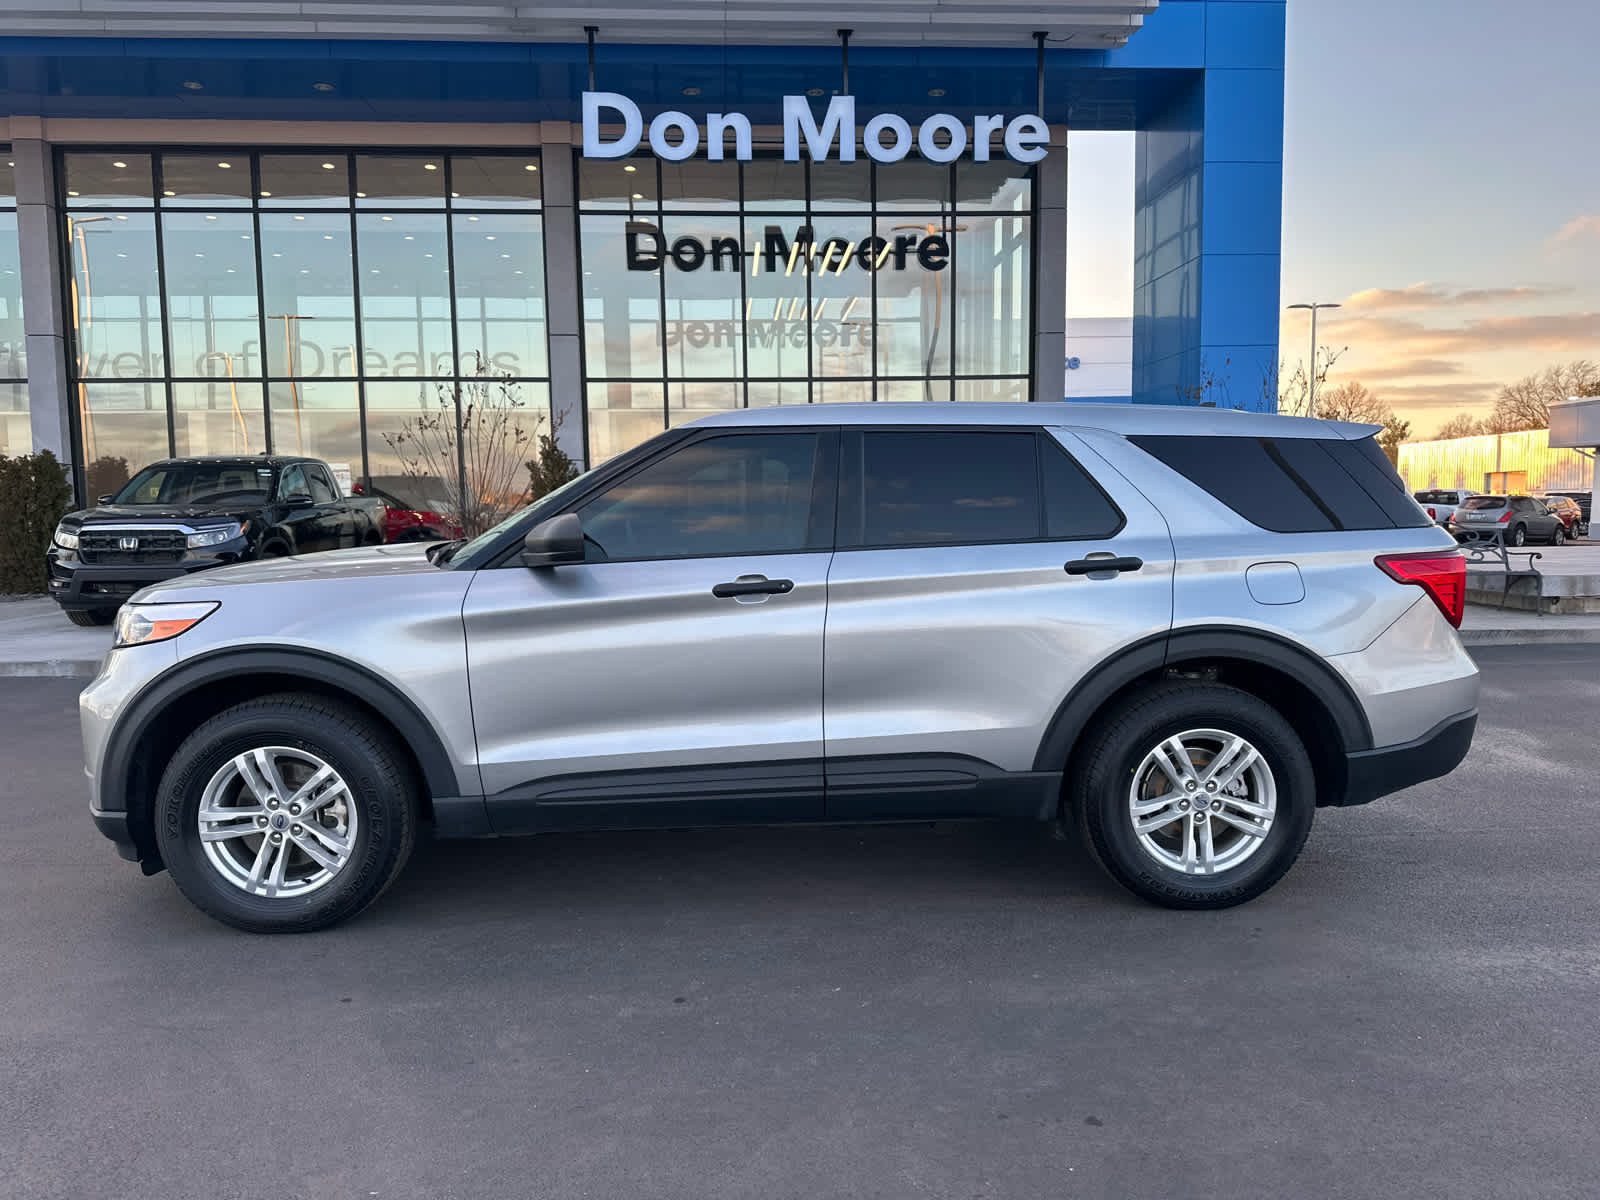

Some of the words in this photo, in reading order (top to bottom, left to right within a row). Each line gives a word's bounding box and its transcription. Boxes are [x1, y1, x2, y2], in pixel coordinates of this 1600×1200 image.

[582, 91, 752, 162] Don
[783, 95, 1051, 164] Moore
[625, 221, 740, 272] Don
[764, 225, 951, 272] Moore
